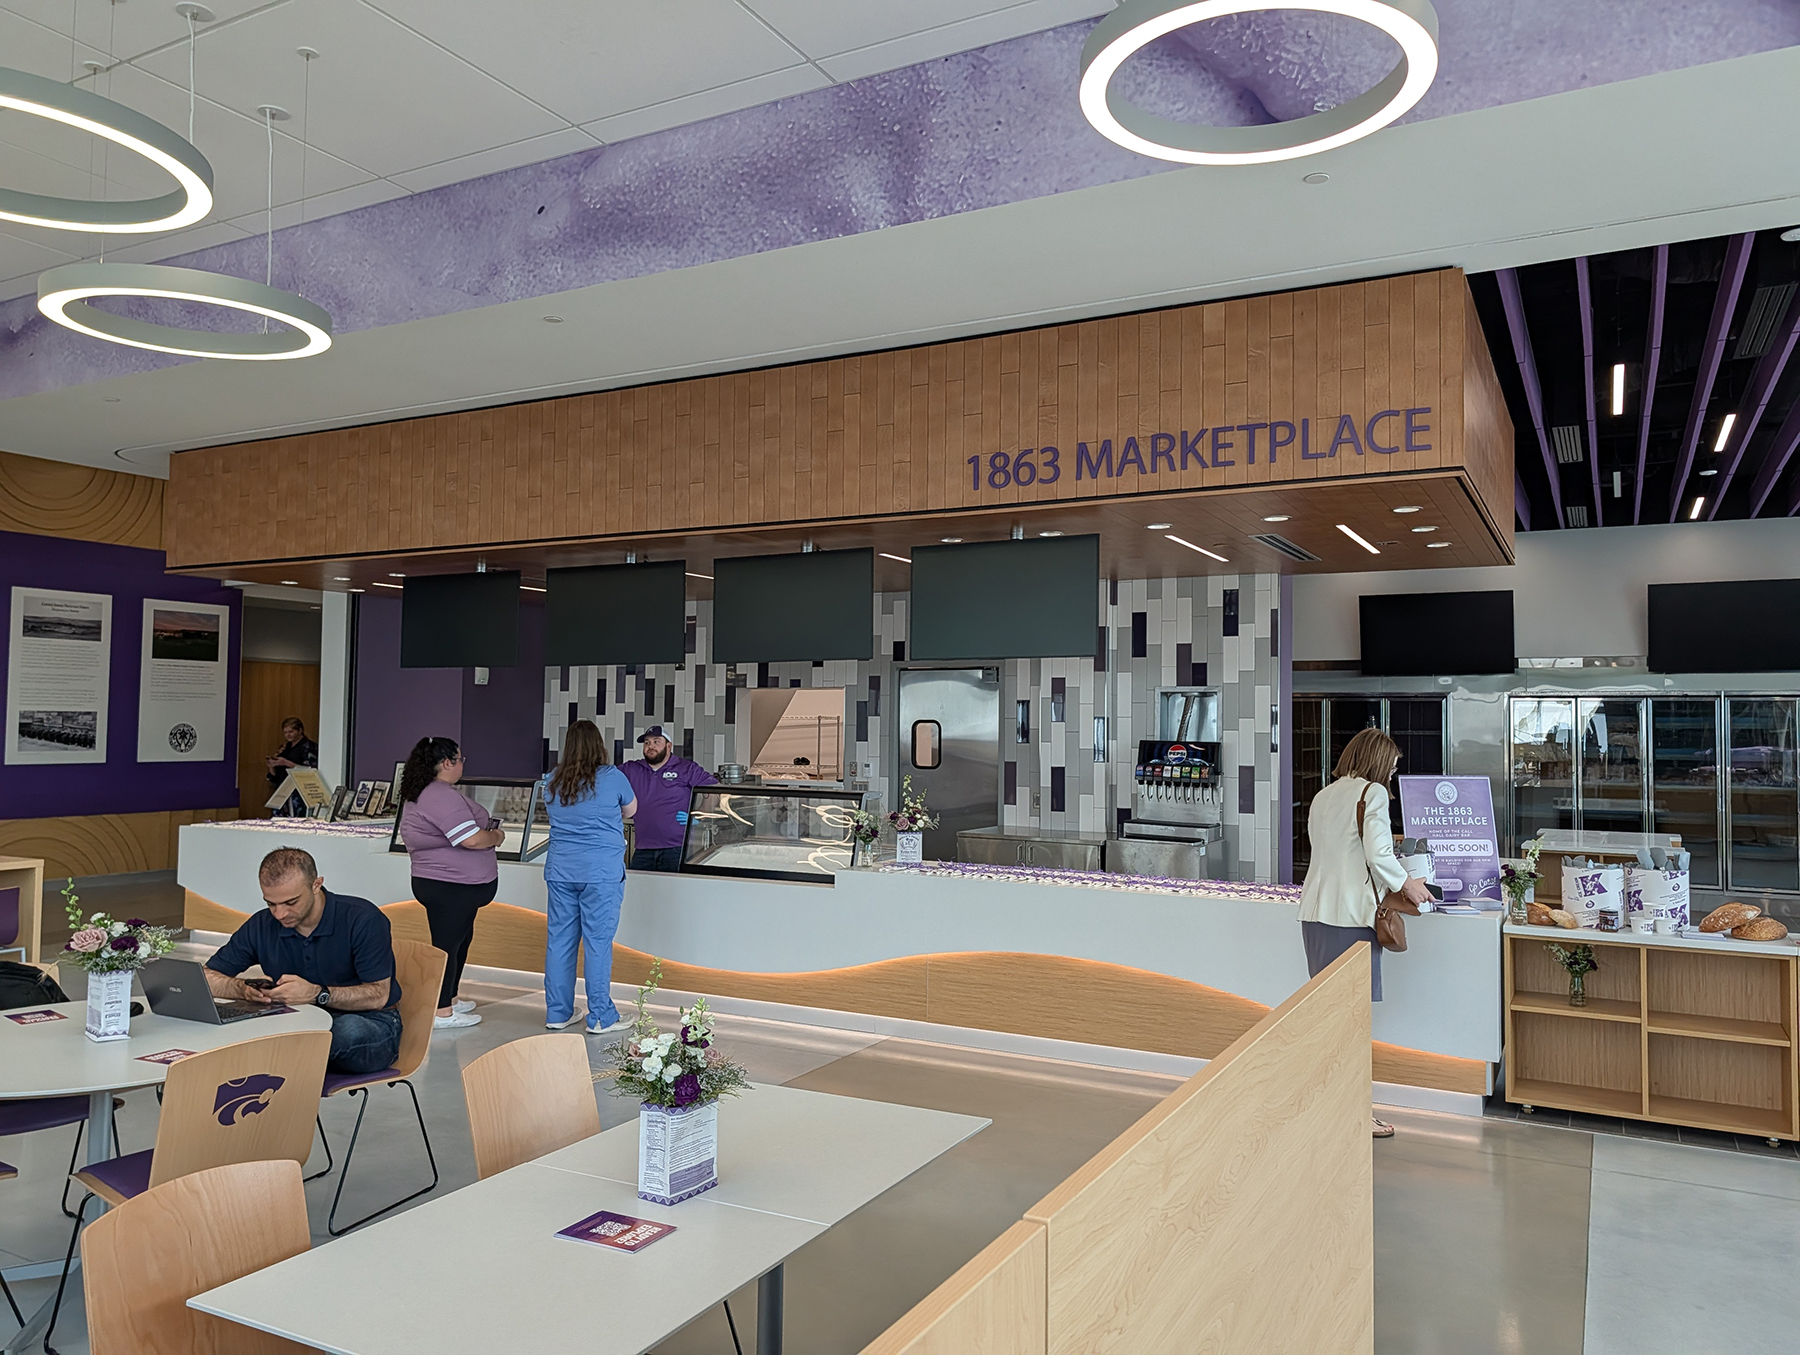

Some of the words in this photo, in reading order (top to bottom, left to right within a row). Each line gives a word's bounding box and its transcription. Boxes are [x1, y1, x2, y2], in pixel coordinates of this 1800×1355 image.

[967, 447, 1060, 491] 1863
[1075, 407, 1432, 480] MARKETPLACE
[1424, 806, 1444, 816] THE
[1448, 806, 1473, 816] 1863
[1411, 816, 1488, 826] MARKETPLACE
[1428, 844, 1456, 852] MING
